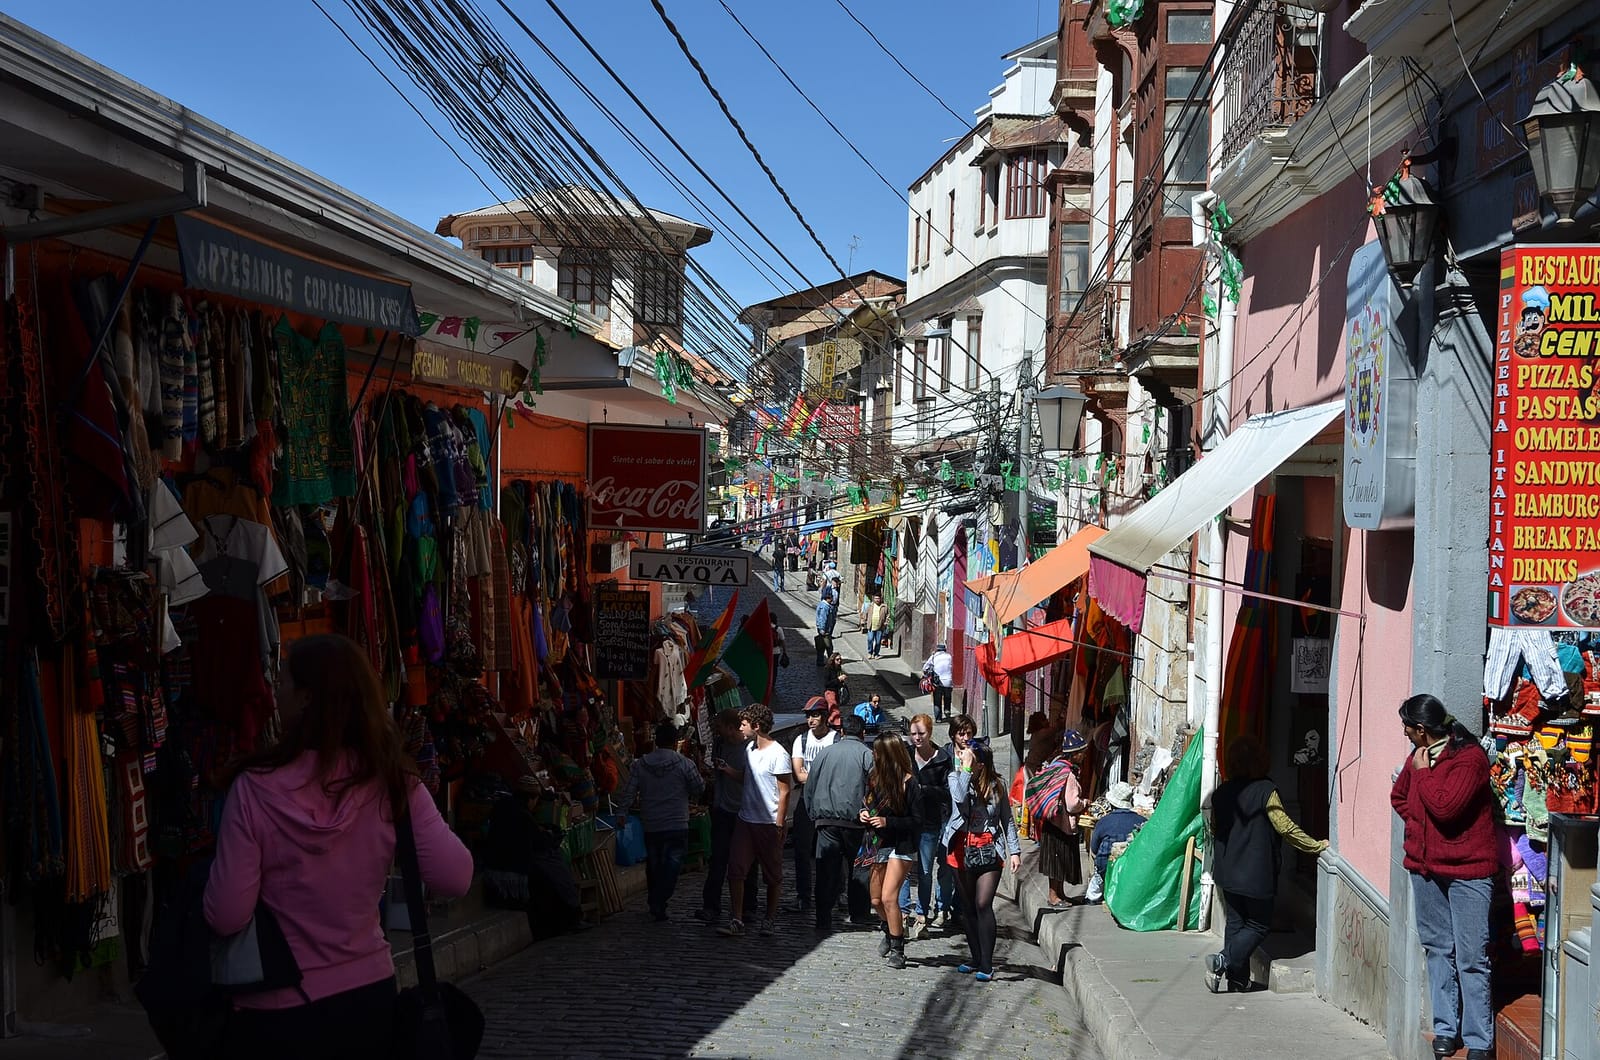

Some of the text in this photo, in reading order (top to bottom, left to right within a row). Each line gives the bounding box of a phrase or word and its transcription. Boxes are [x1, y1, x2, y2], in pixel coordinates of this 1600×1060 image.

[197, 240, 293, 304] ARTESANIAS
[304, 275, 375, 322] COPACABANA
[1549, 295, 1600, 321] MIL
[824, 344, 835, 387] COCA
[1517, 365, 1593, 388] PIZZAS
[1516, 396, 1597, 419] PASTAS
[1490, 294, 1512, 587] PIZZERIA ITALIANA
[612, 456, 634, 465] Siente
[636, 456, 643, 464] el
[644, 456, 664, 465] sabor
[666, 457, 676, 465] de
[1513, 526, 1600, 550] BREAK FA
[677, 557, 735, 567] RESTAURANT
[1512, 558, 1578, 583] DRINKS
